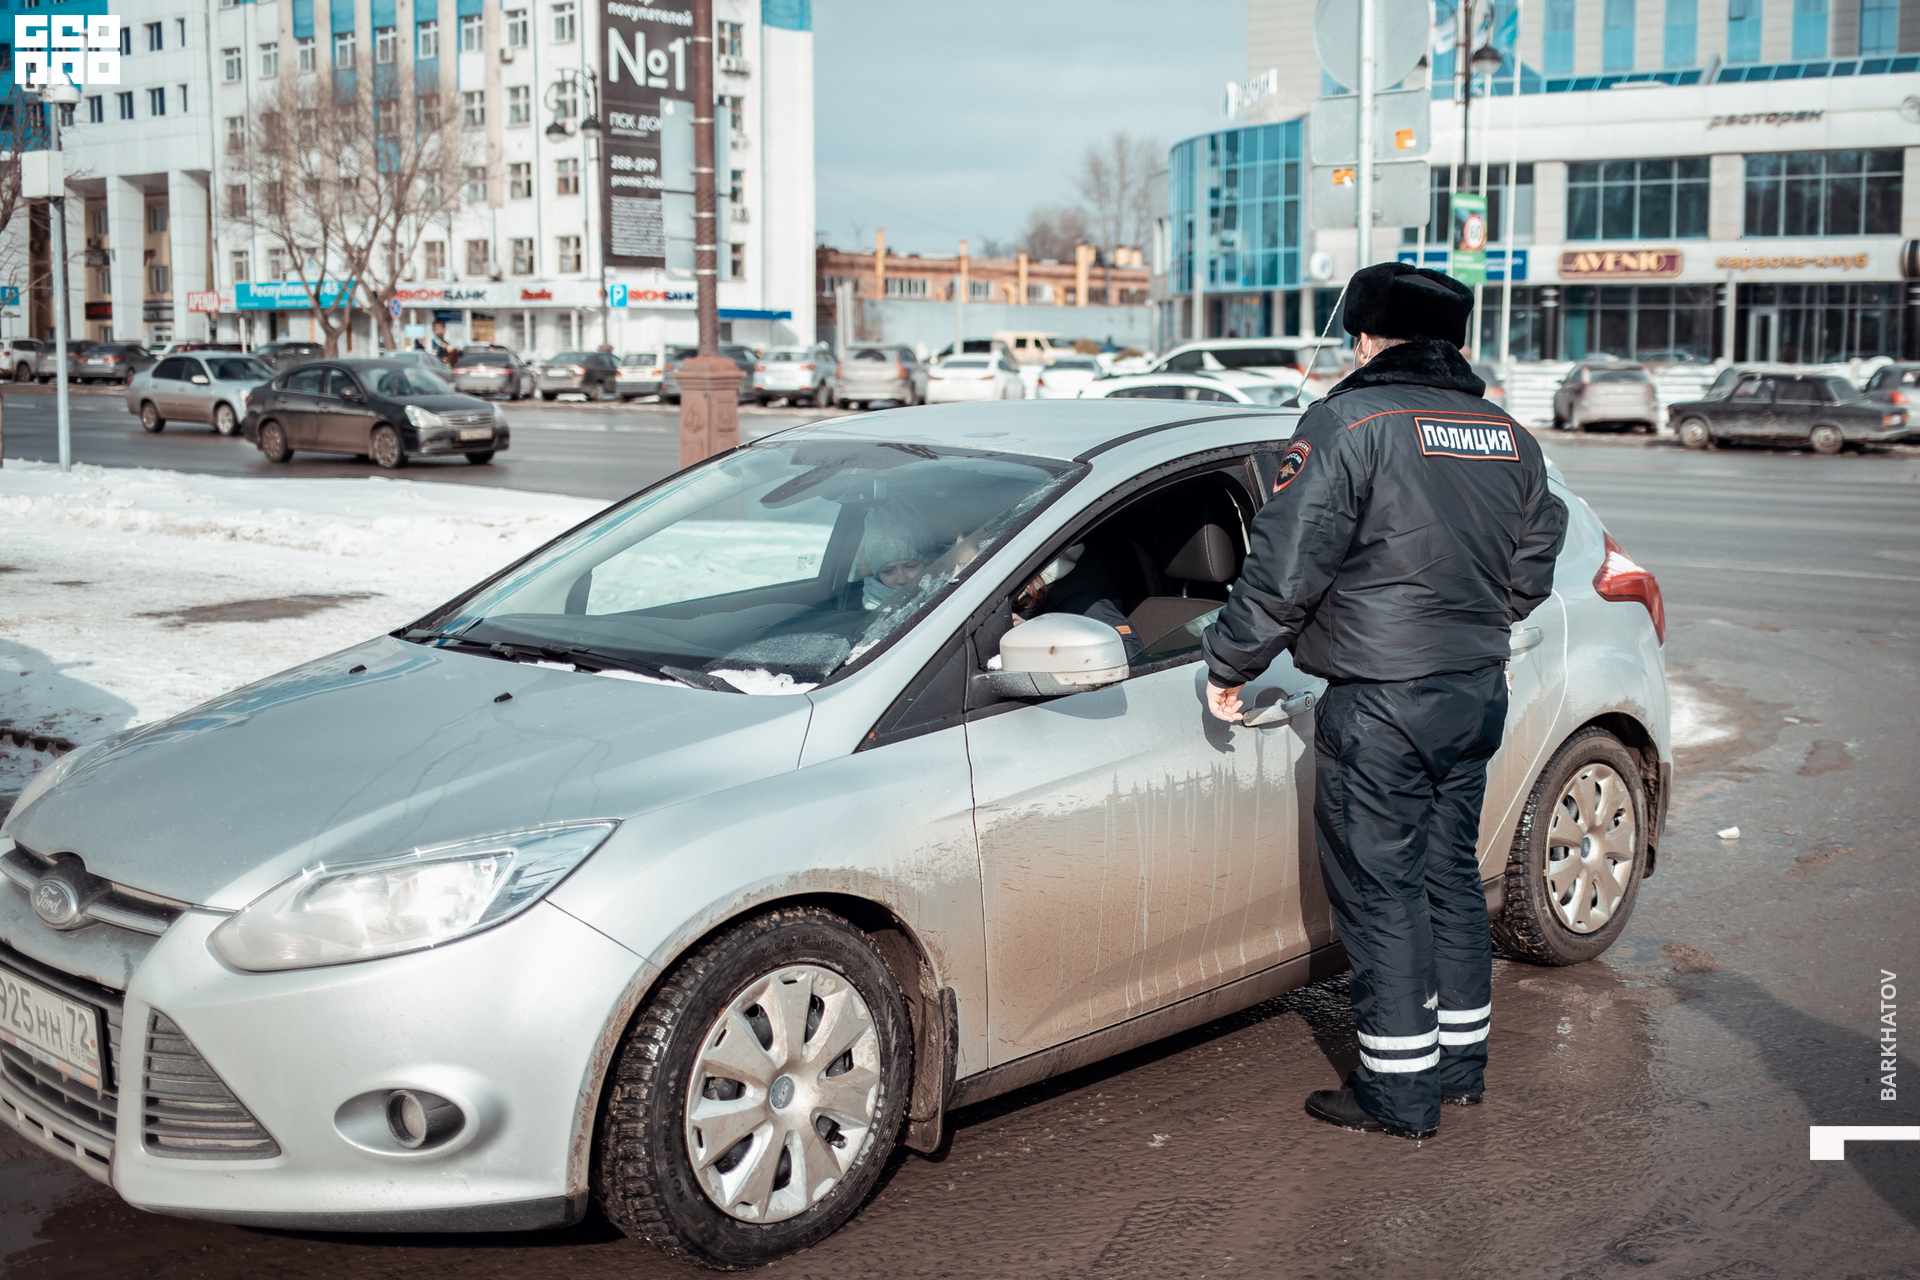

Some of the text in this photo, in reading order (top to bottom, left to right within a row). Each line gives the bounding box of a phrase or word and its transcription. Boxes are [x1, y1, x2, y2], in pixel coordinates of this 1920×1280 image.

[607, 1, 693, 27] покупателей
[609, 111, 637, 129] ПСК
[1716, 251, 1869, 271] караоке-клуб
[189, 293, 219, 311] АРЕНДА
[395, 289, 487, 301] ВКОМБАНК
[1422, 425, 1513, 455] ПОЛИЦИЯ
[35, 886, 62, 915] Ford
[65, 1005, 91, 1050] 72
[69, 1043, 87, 1062] RUS
